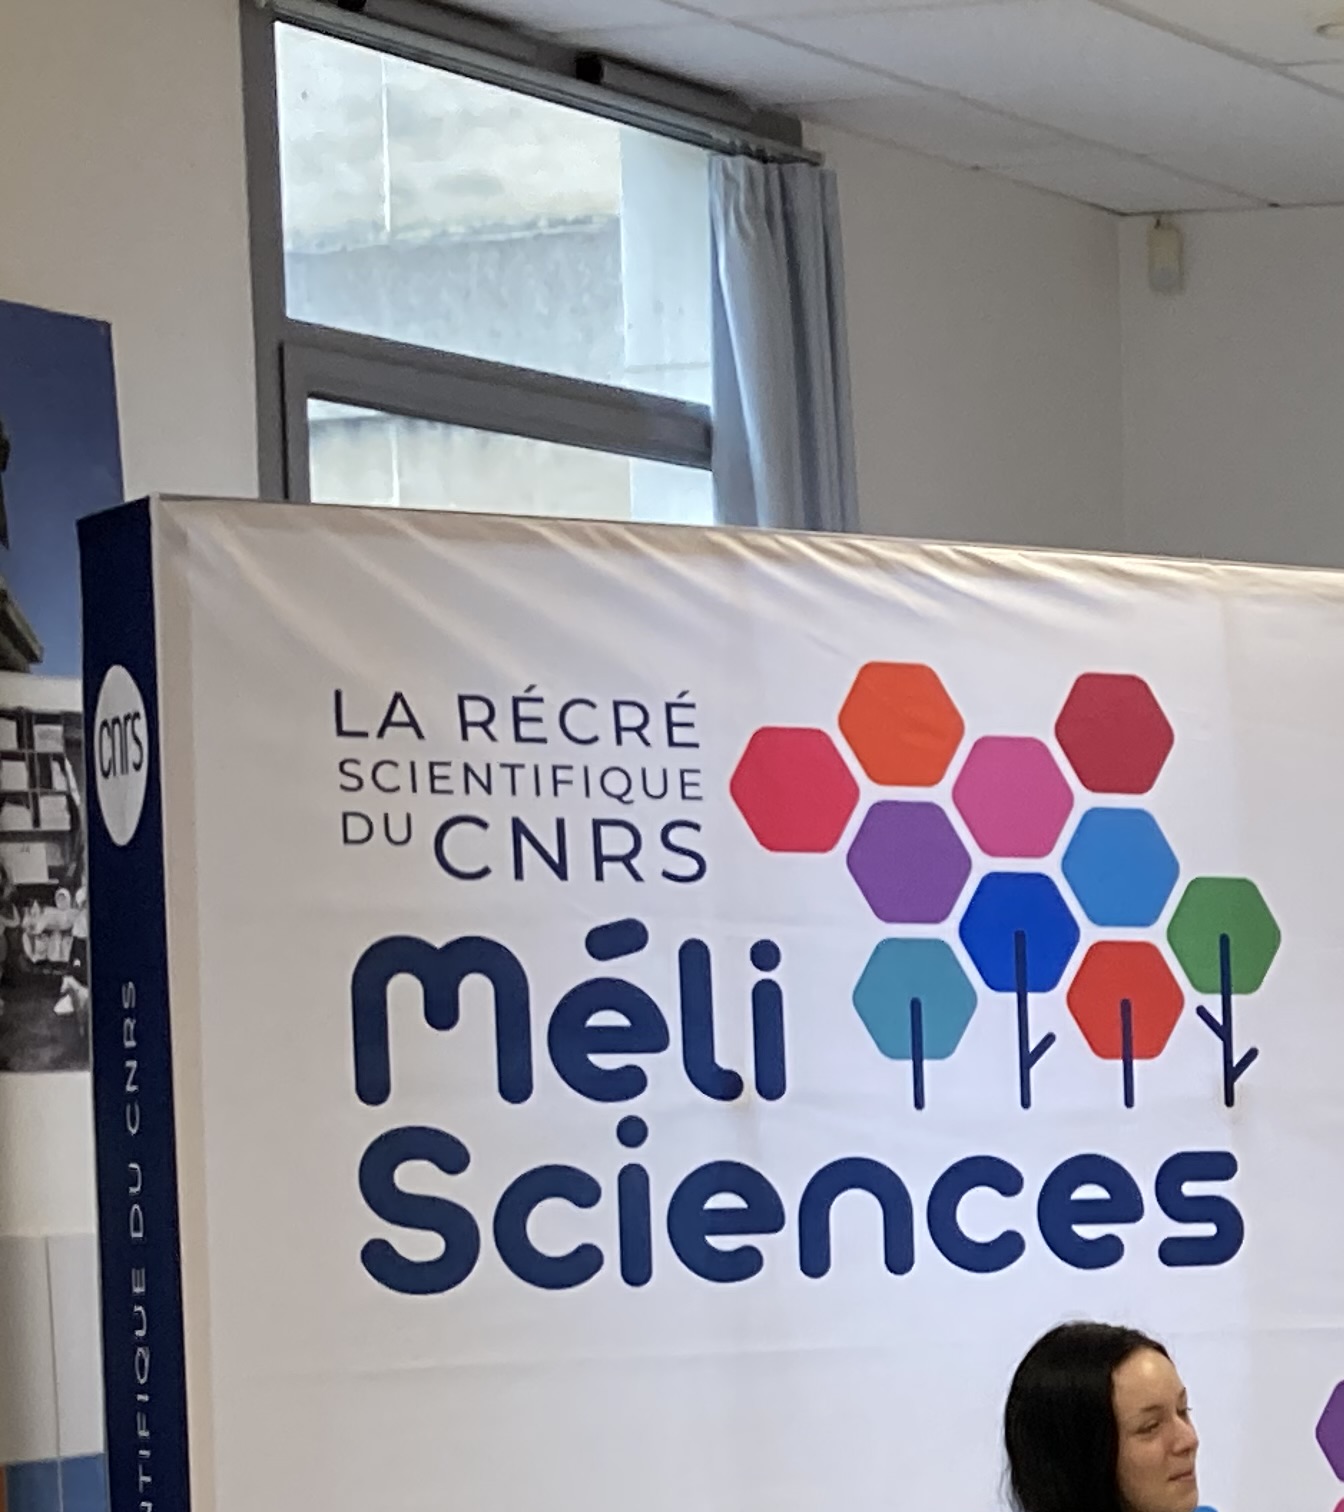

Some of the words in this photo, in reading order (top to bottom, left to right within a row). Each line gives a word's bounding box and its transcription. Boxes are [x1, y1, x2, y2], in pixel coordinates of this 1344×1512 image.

[100, 711, 144, 779] cnrs
[333, 688, 425, 741] LA
[457, 684, 701, 749] RÉCRÉ
[338, 758, 703, 806] SCIENTIFIQUE
[341, 810, 413, 847] DU
[433, 814, 708, 884] CNRS
[121, 980, 141, 1136] CNRS
[128, 1162, 144, 1239] DU
[357, 1114, 1246, 1297] Sciences
